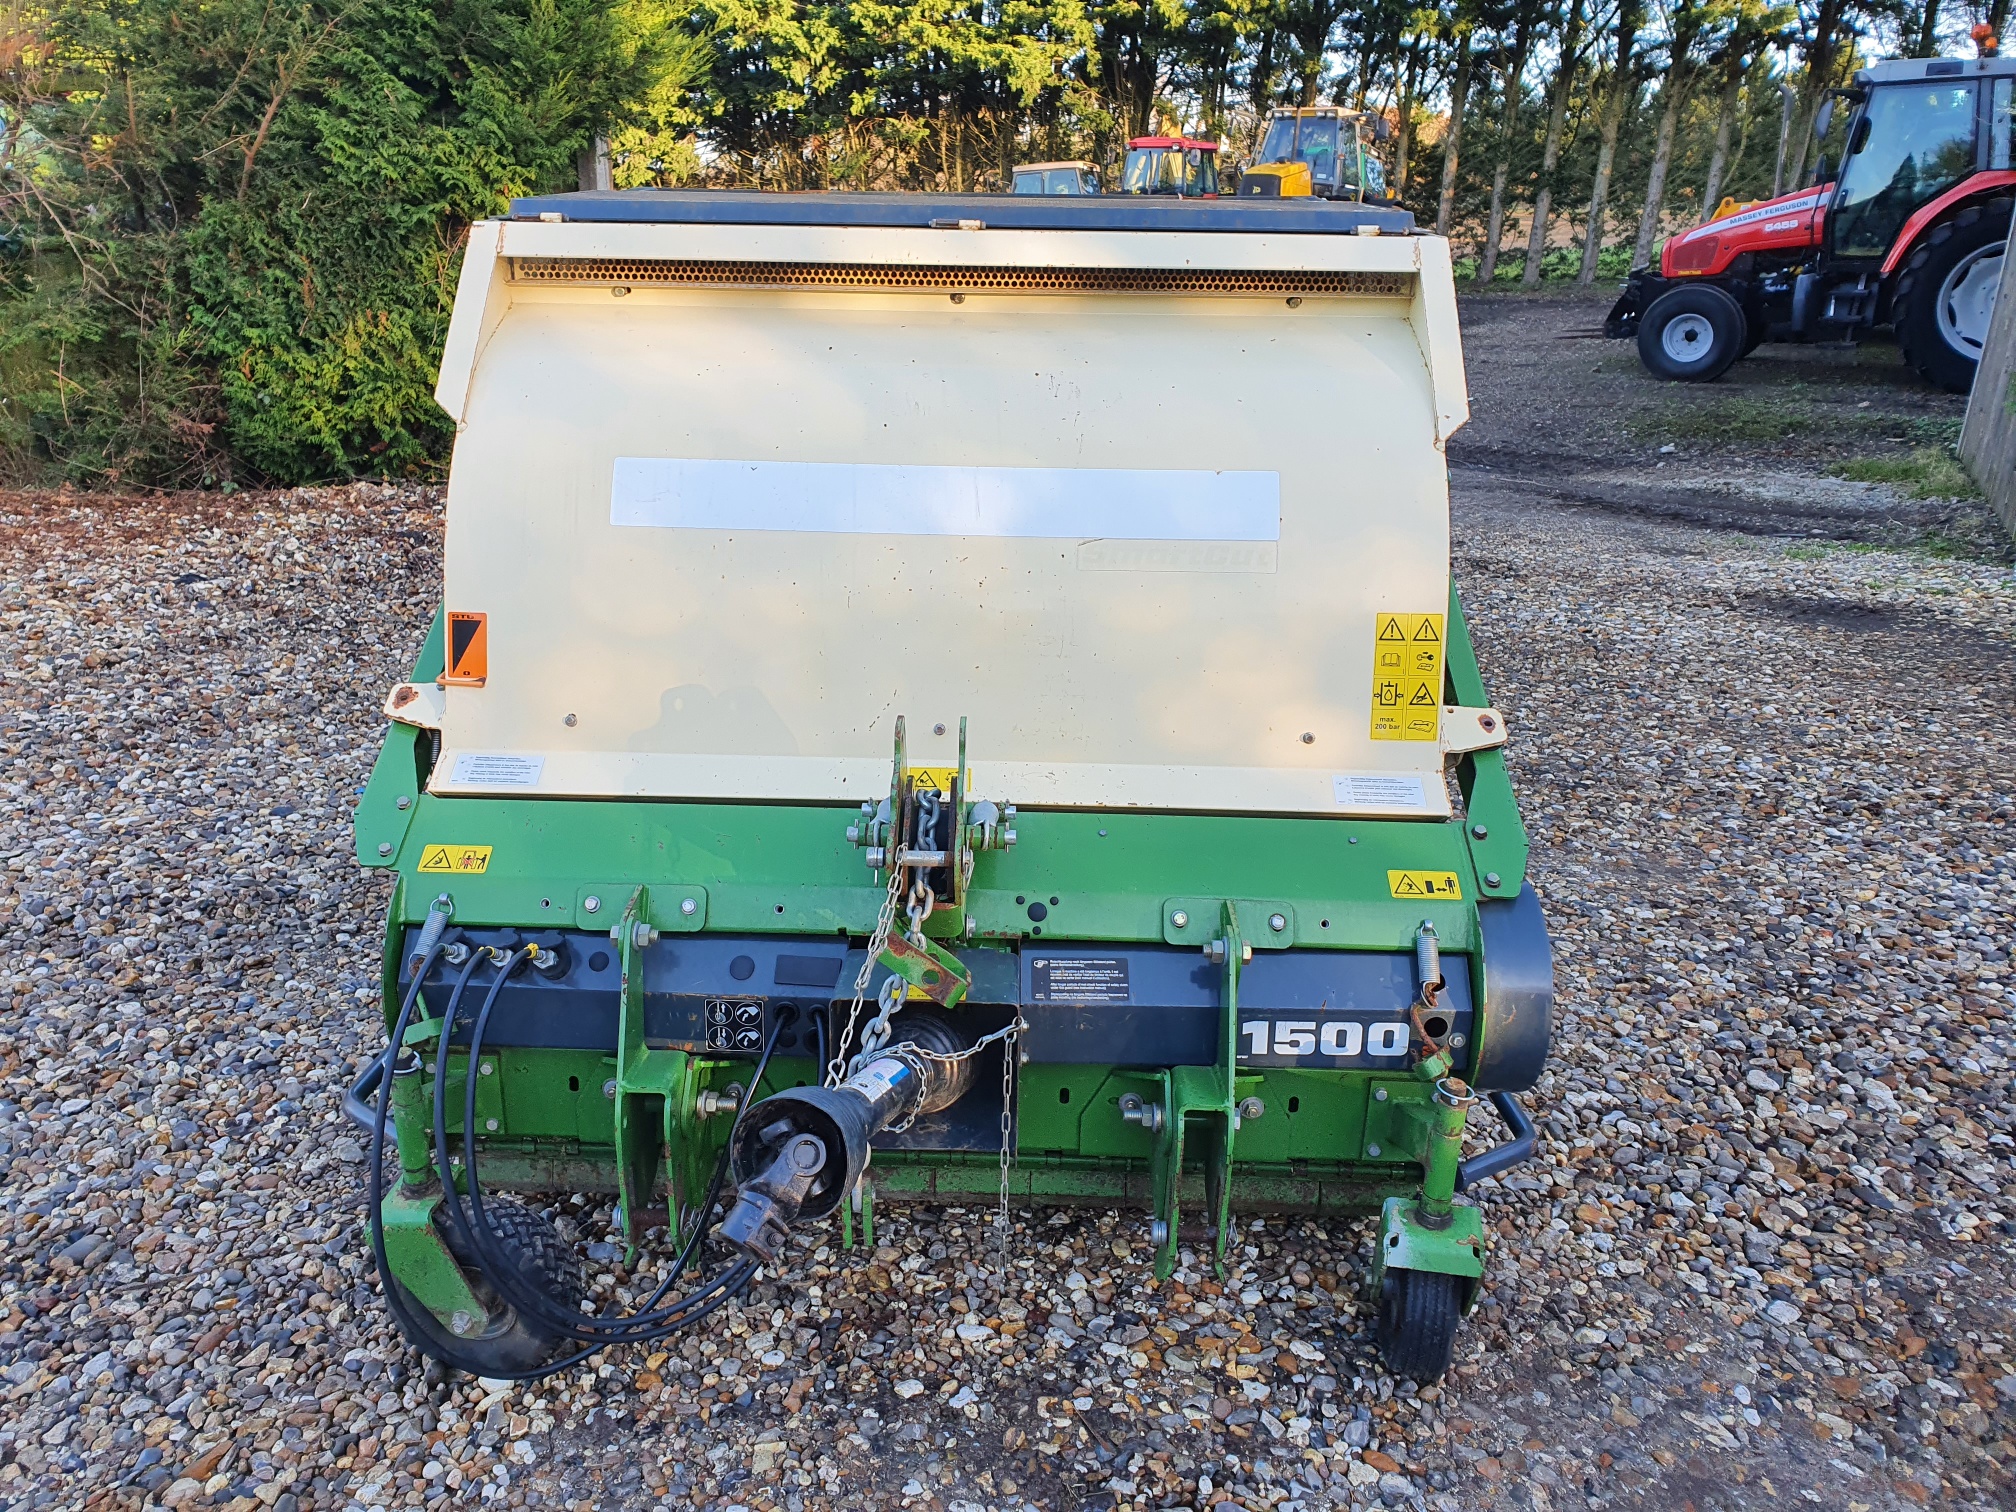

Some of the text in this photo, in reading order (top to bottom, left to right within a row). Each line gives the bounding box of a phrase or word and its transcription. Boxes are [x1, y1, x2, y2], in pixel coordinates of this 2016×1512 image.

[1730, 200, 1809, 225] MASSEY FERGUSON
[1242, 1020, 1410, 1056] 1500
